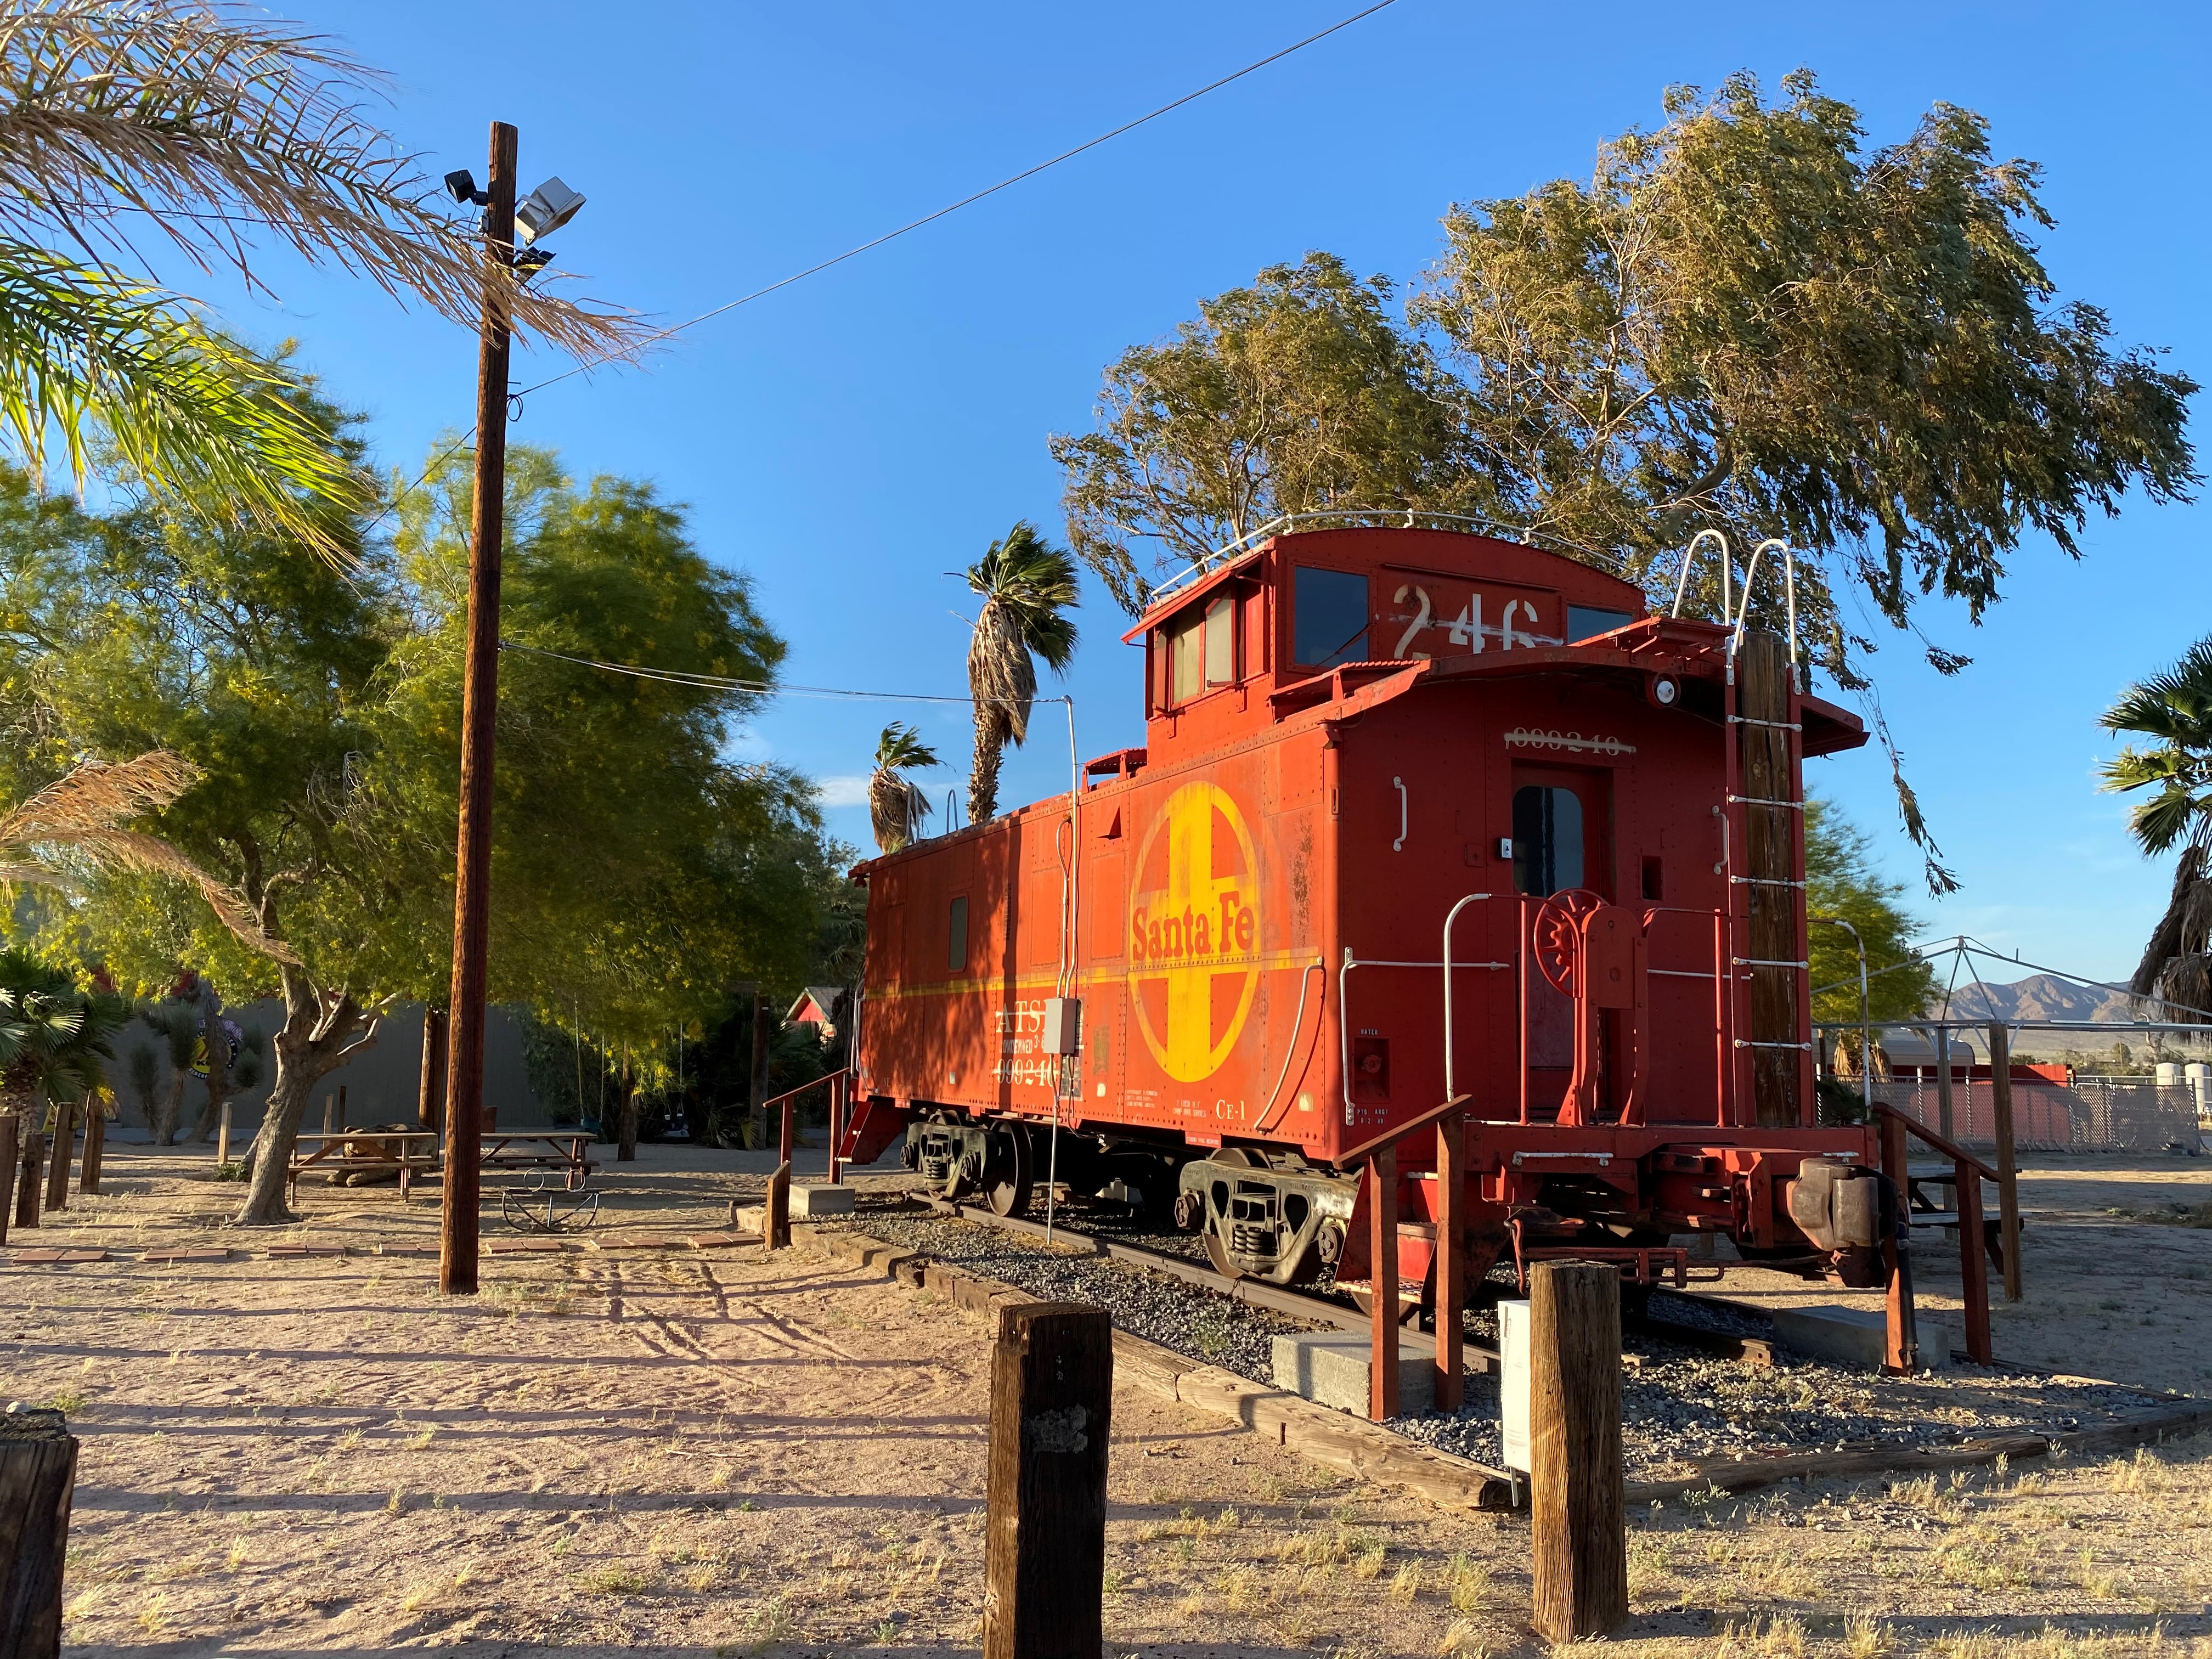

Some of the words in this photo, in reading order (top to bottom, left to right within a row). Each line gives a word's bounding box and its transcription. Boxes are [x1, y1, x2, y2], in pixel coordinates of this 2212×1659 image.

[1393, 584, 1538, 659] 246
[1132, 904, 1211, 961] Santa
[1219, 890, 1255, 952] Fe
[996, 1000, 1046, 1032] ATS
